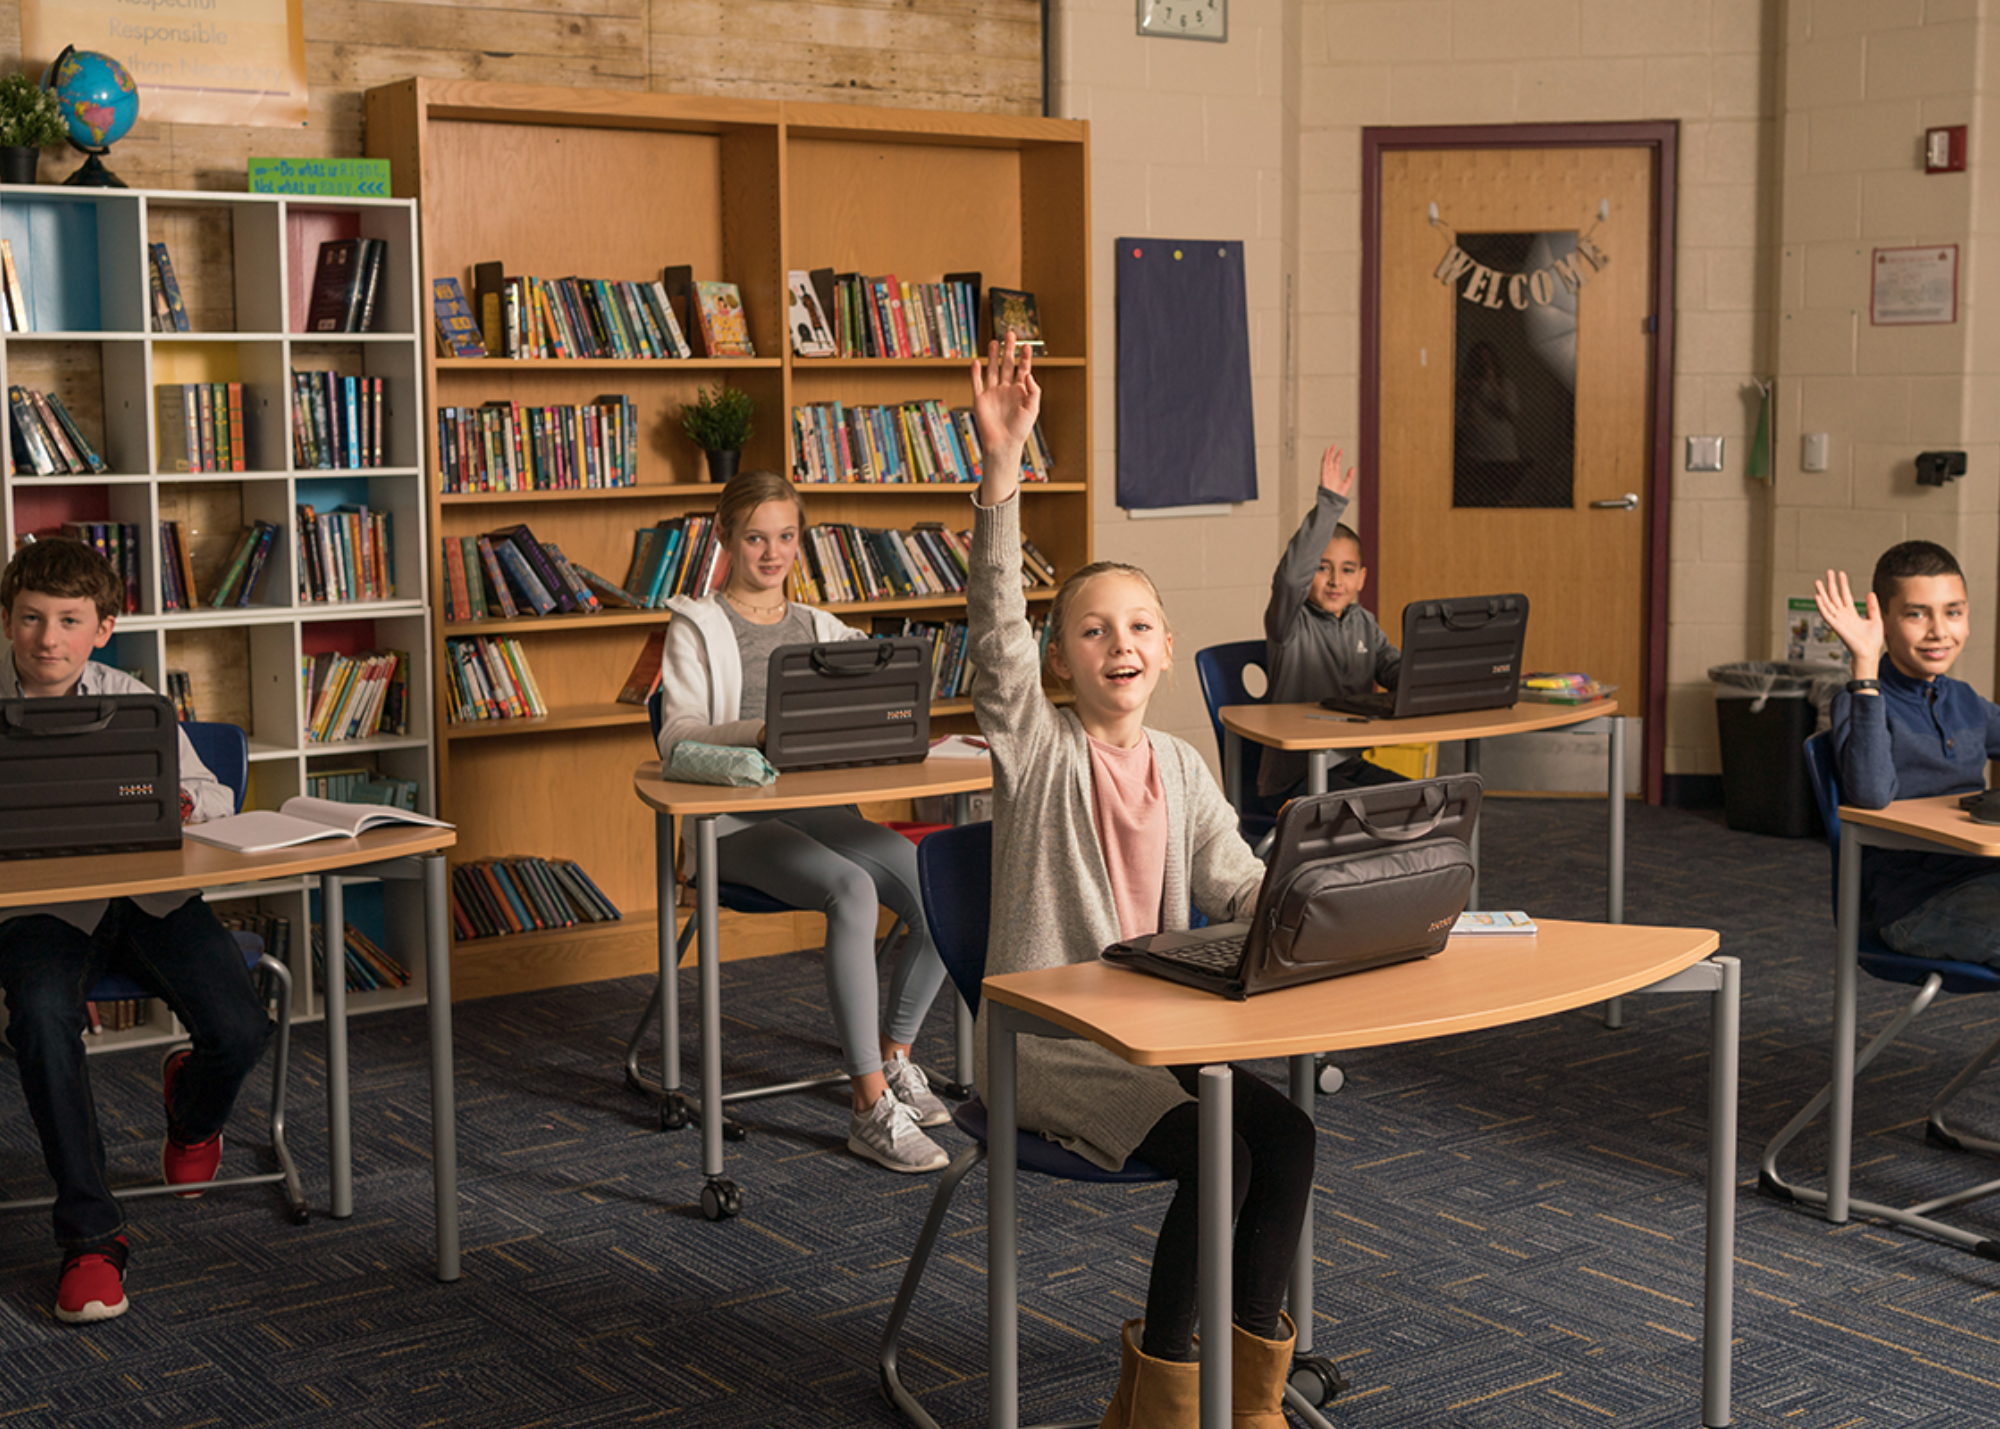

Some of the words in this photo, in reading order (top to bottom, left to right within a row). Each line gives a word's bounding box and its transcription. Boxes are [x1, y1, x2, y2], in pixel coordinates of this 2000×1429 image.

[1165, 7, 1173, 20] 7
[1179, 14, 1187, 27] 6
[1196, 10, 1204, 23] 5
[109, 16, 228, 46] Responsible
[128, 51, 173, 75] than
[1433, 236, 1610, 310] WELCOME
